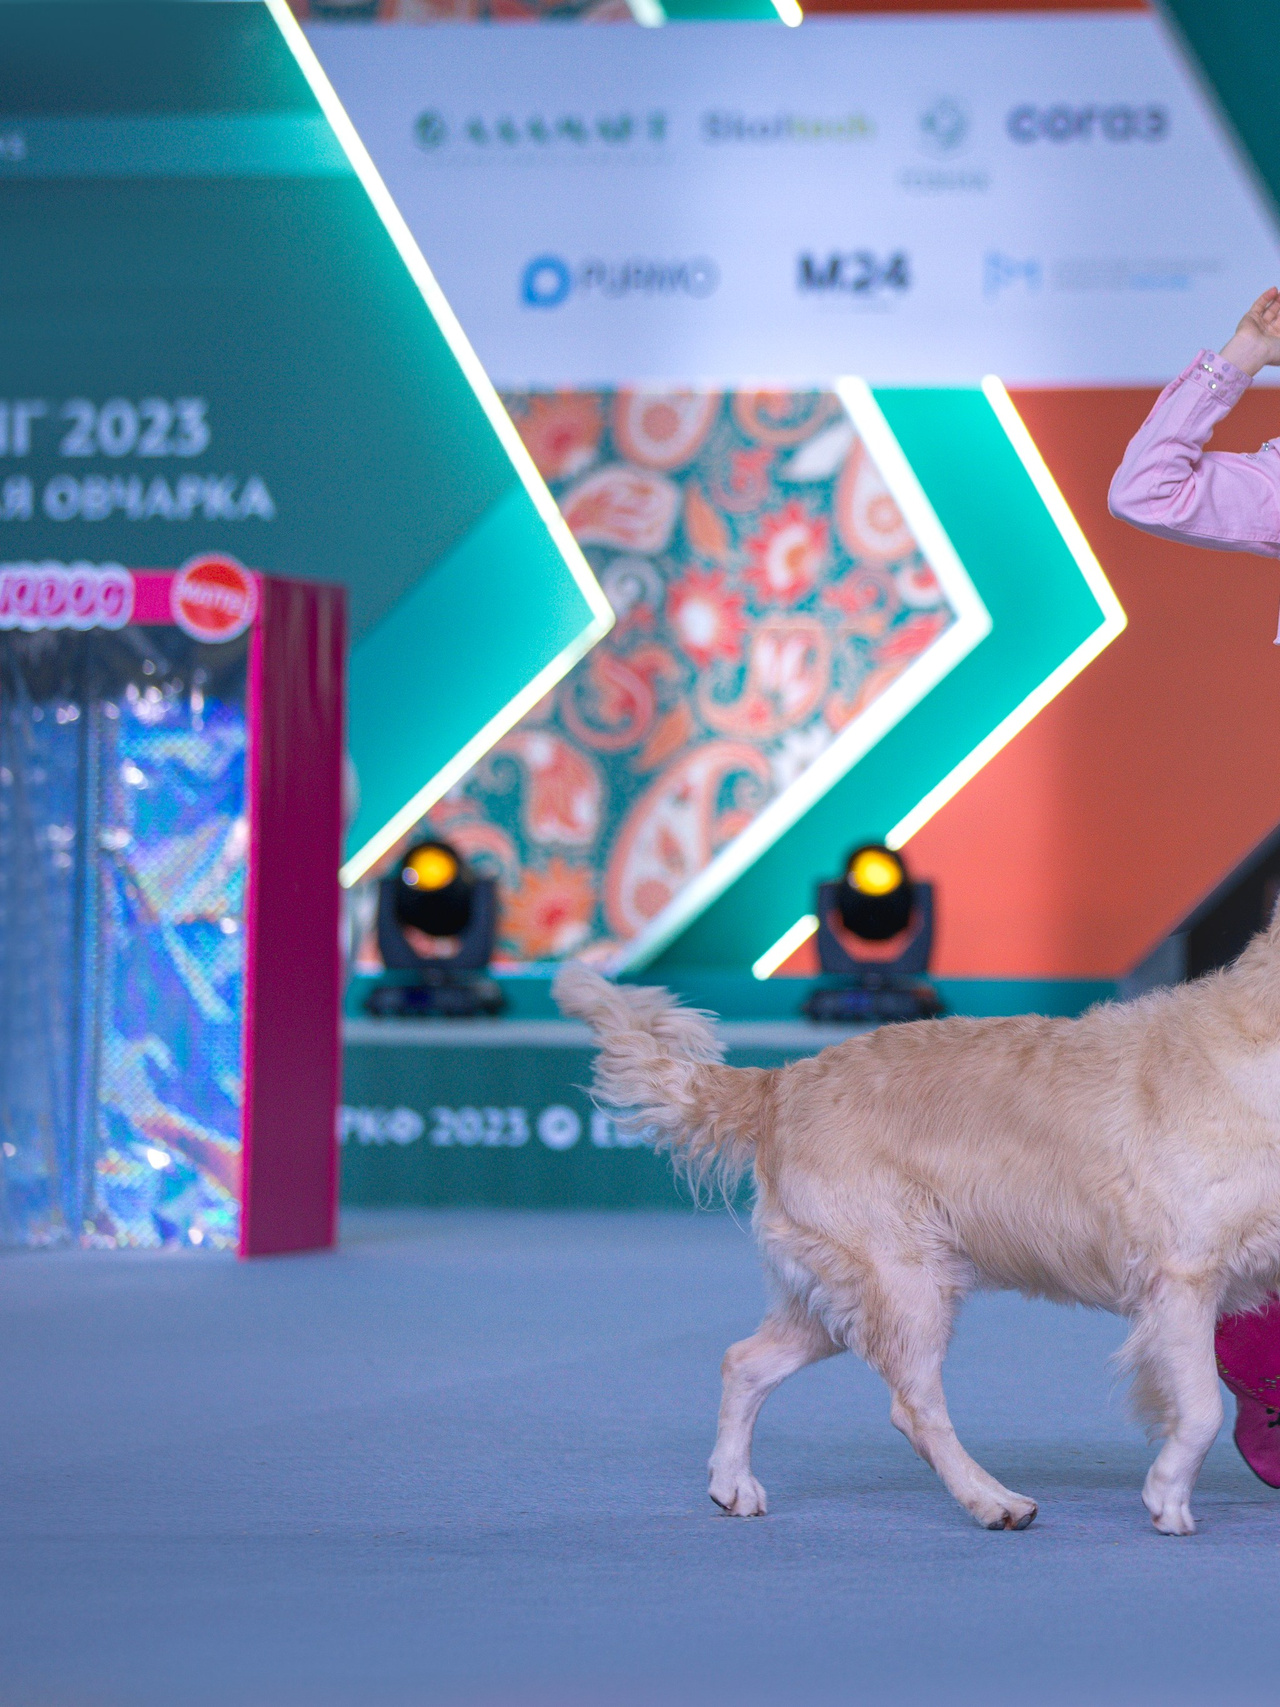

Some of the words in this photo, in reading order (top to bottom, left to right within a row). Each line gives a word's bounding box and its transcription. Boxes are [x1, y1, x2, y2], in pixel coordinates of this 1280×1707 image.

[0, 398, 48, 456] Г
[60, 397, 211, 457] 2023
[0, 474, 35, 521] Я
[43, 473, 277, 522] ОВЧАРКА
[430, 1104, 529, 1147] 2023
